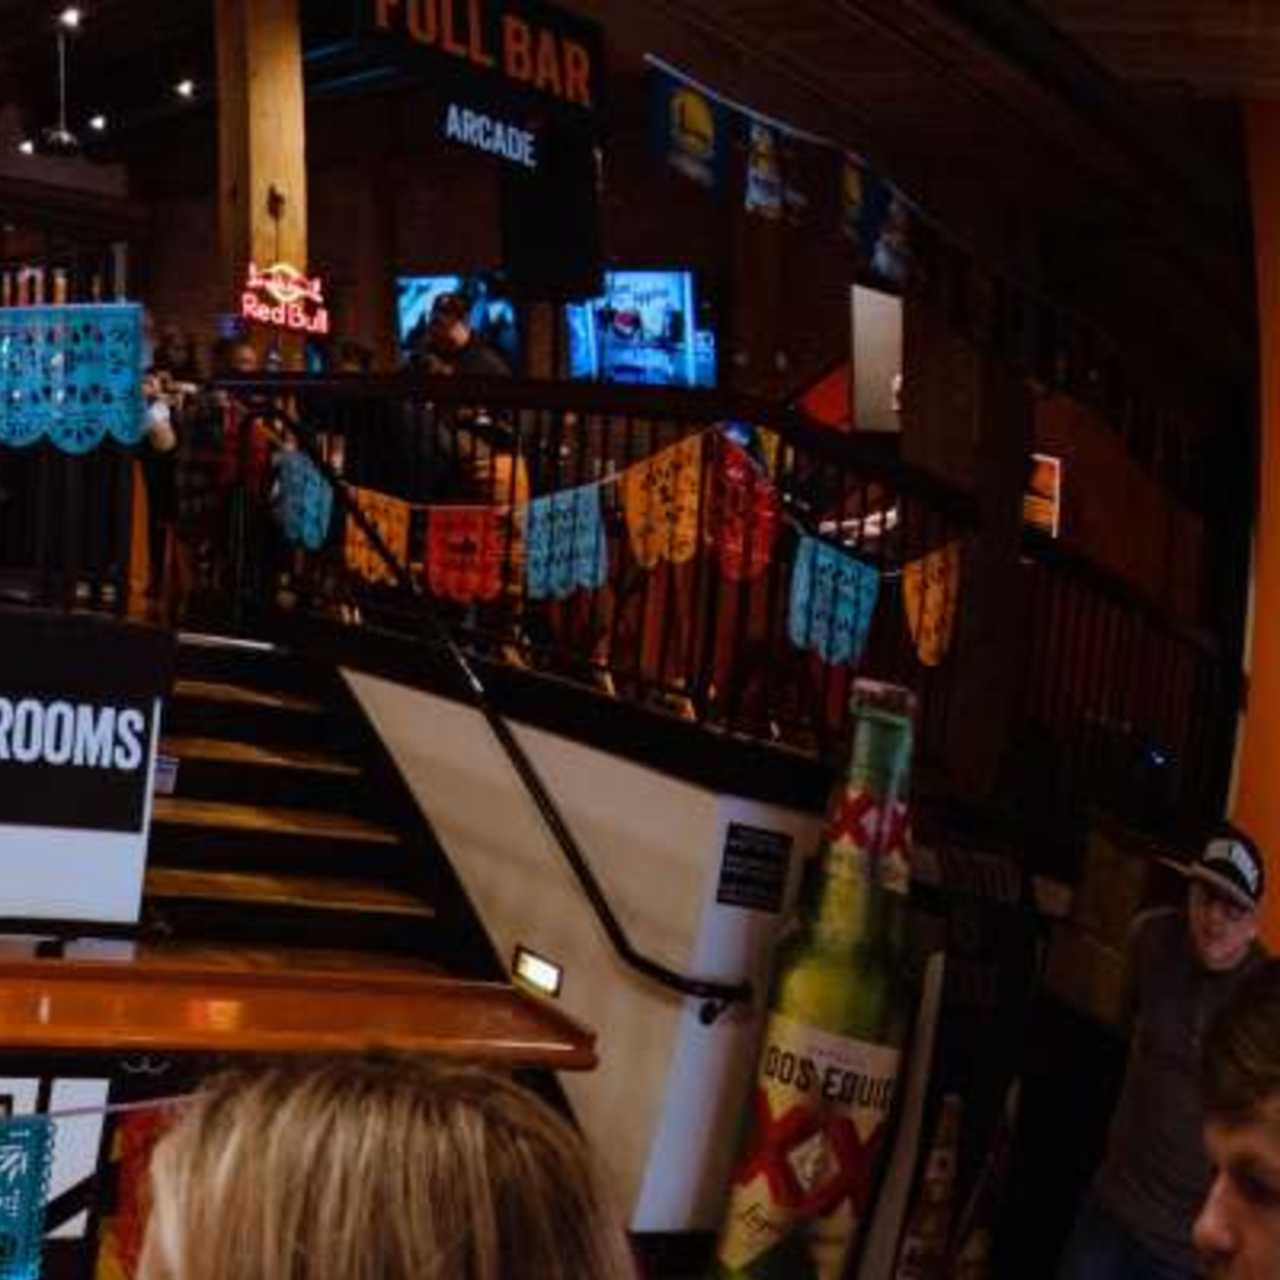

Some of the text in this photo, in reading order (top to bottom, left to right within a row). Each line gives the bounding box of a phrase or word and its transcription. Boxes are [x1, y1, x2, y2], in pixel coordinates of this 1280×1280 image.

[501, 13, 590, 107] BAR
[445, 103, 537, 167] ARCADE
[241, 290, 329, 334] Red Bull
[765, 1045, 817, 1092] DOS
